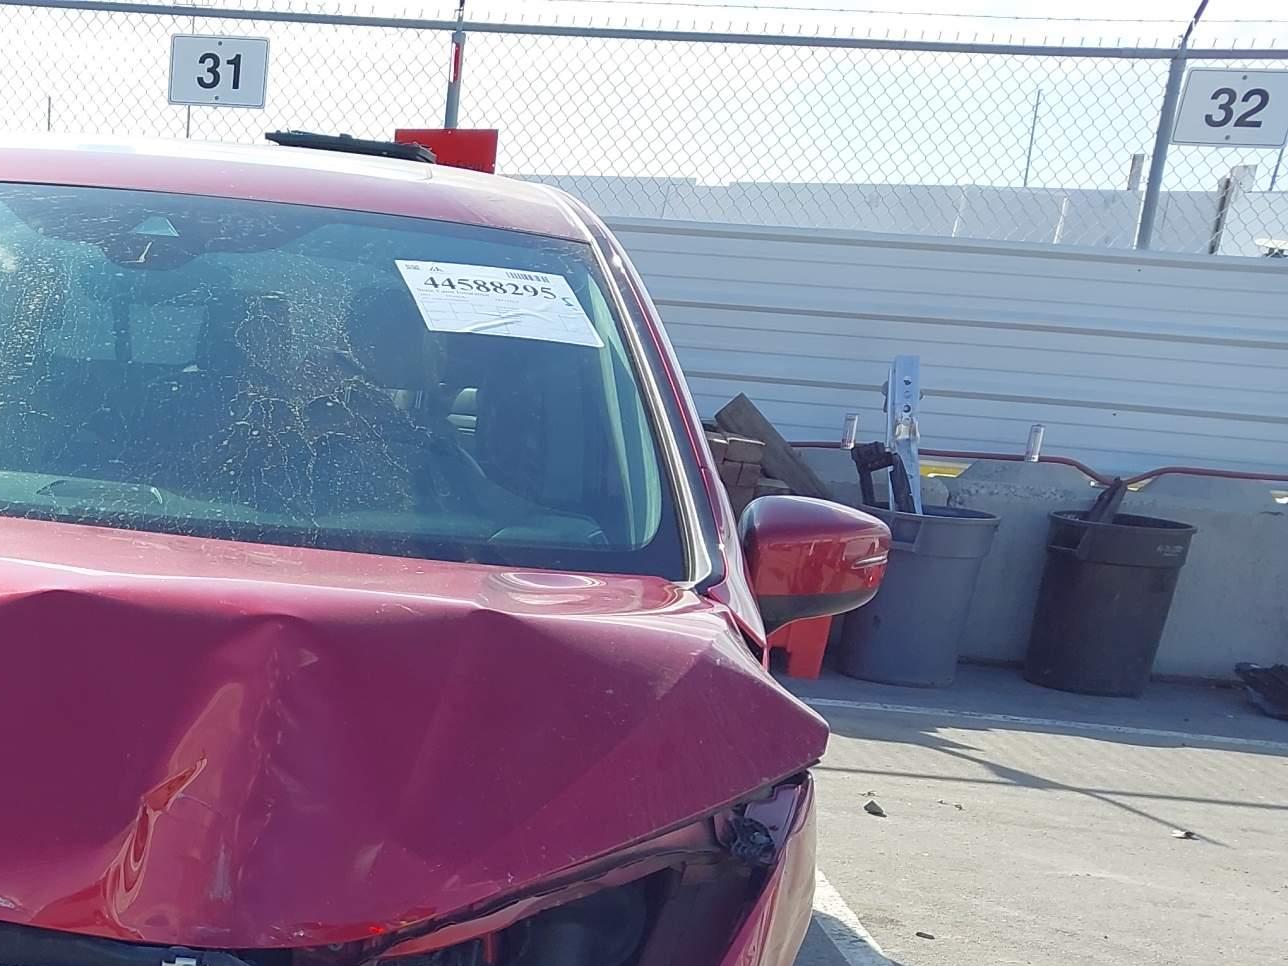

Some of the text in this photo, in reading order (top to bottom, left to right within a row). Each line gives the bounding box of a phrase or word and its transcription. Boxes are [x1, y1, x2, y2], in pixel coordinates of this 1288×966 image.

[197, 53, 241, 89] 31
[1204, 87, 1270, 128] 32
[423, 276, 557, 300] 44588295
